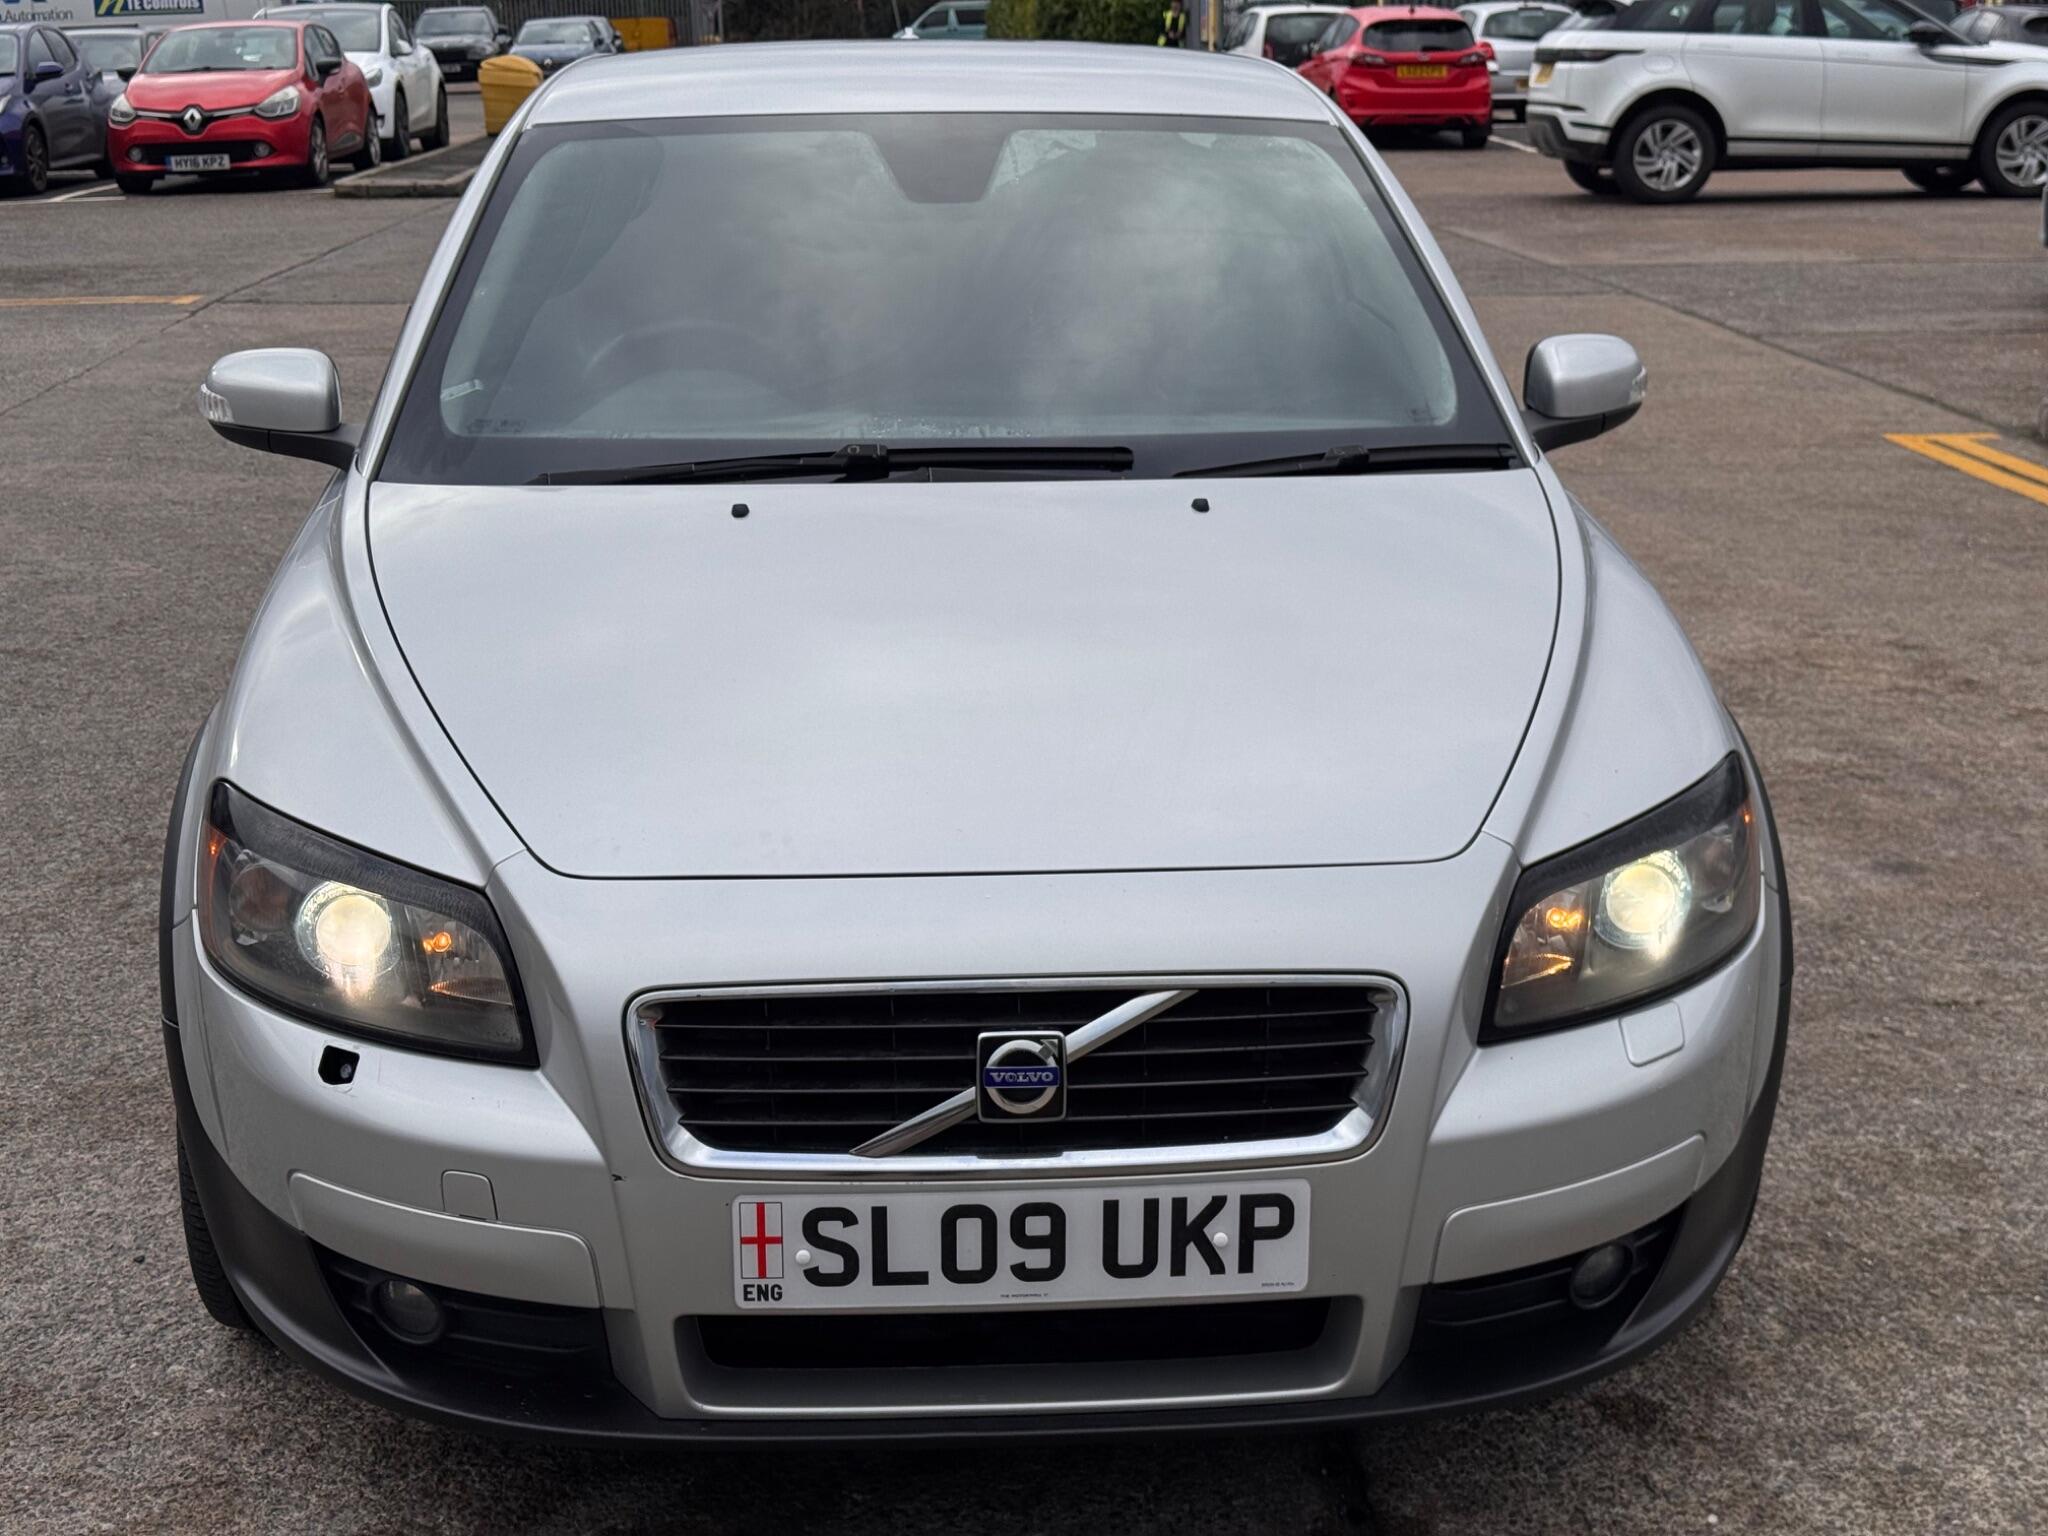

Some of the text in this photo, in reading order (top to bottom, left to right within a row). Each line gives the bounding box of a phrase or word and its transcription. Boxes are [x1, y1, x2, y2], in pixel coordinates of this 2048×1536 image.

[5, 7, 73, 23] Automation
[989, 1071, 1054, 1083] VOLVO
[802, 1192, 1295, 1287] SL09 UKP
[743, 1284, 783, 1301] ENG
